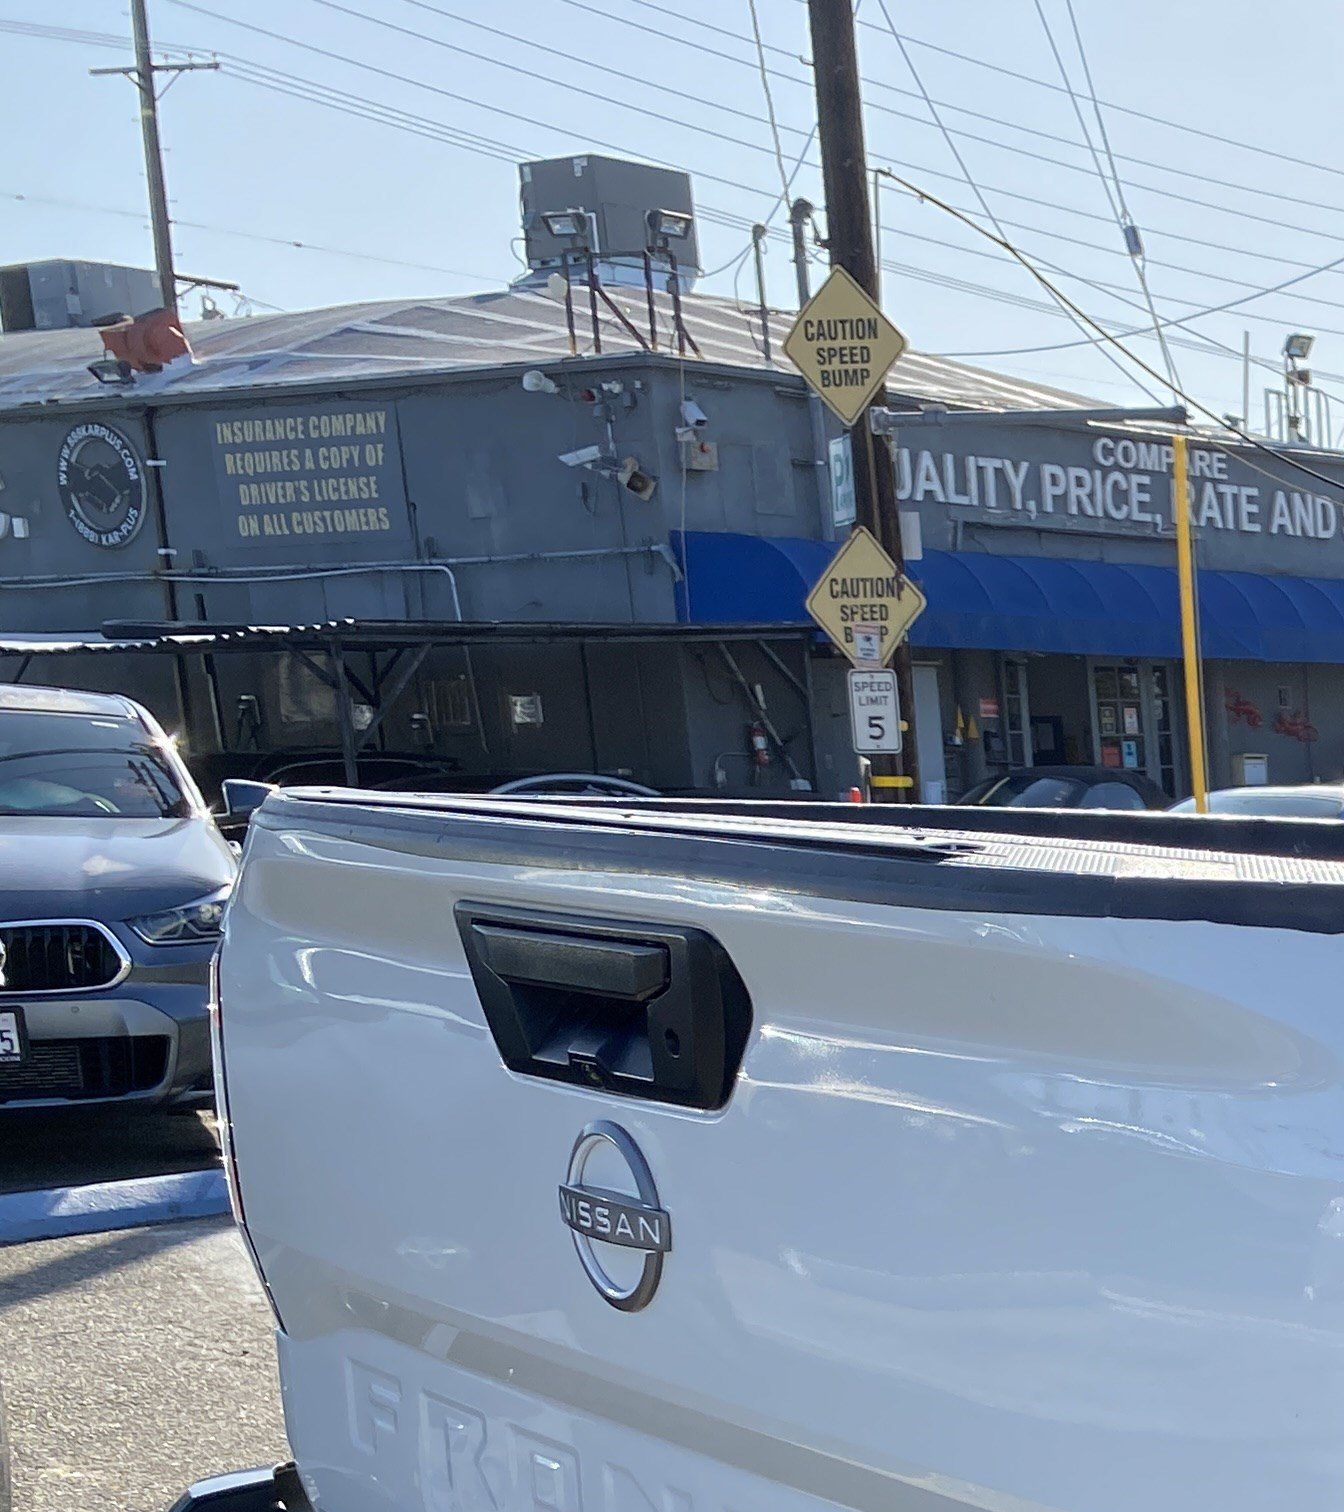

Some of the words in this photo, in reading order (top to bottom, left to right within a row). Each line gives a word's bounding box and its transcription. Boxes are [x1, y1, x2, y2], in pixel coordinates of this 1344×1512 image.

[804, 318, 878, 342] CAUTION
[816, 346, 871, 366] SPEED
[821, 368, 870, 388] BUMP
[216, 417, 305, 444] INSURANCE
[309, 411, 386, 438] COMPANY
[225, 449, 300, 476] REQUIRES
[304, 449, 315, 470] A
[319, 445, 360, 470] COPY
[365, 443, 384, 467] OF
[239, 480, 310, 505] DRIVER'S
[314, 476, 379, 501] LICENSE
[895, 447, 1036, 520] UALITY,
[1040, 463, 1162, 532] PRICE,
[1270, 490, 1337, 539] AND
[238, 515, 260, 537] ON
[263, 512, 290, 536] ALL
[292, 507, 390, 534] CUSTOMERS
[829, 577, 899, 600] CAUTION
[840, 604, 889, 622] SPEED
[844, 625, 889, 643] BP
[854, 681, 893, 692] SPEED
[858, 695, 889, 706] LIMIT
[868, 716, 885, 740] 5
[560, 1190, 661, 1245] NISSAN
